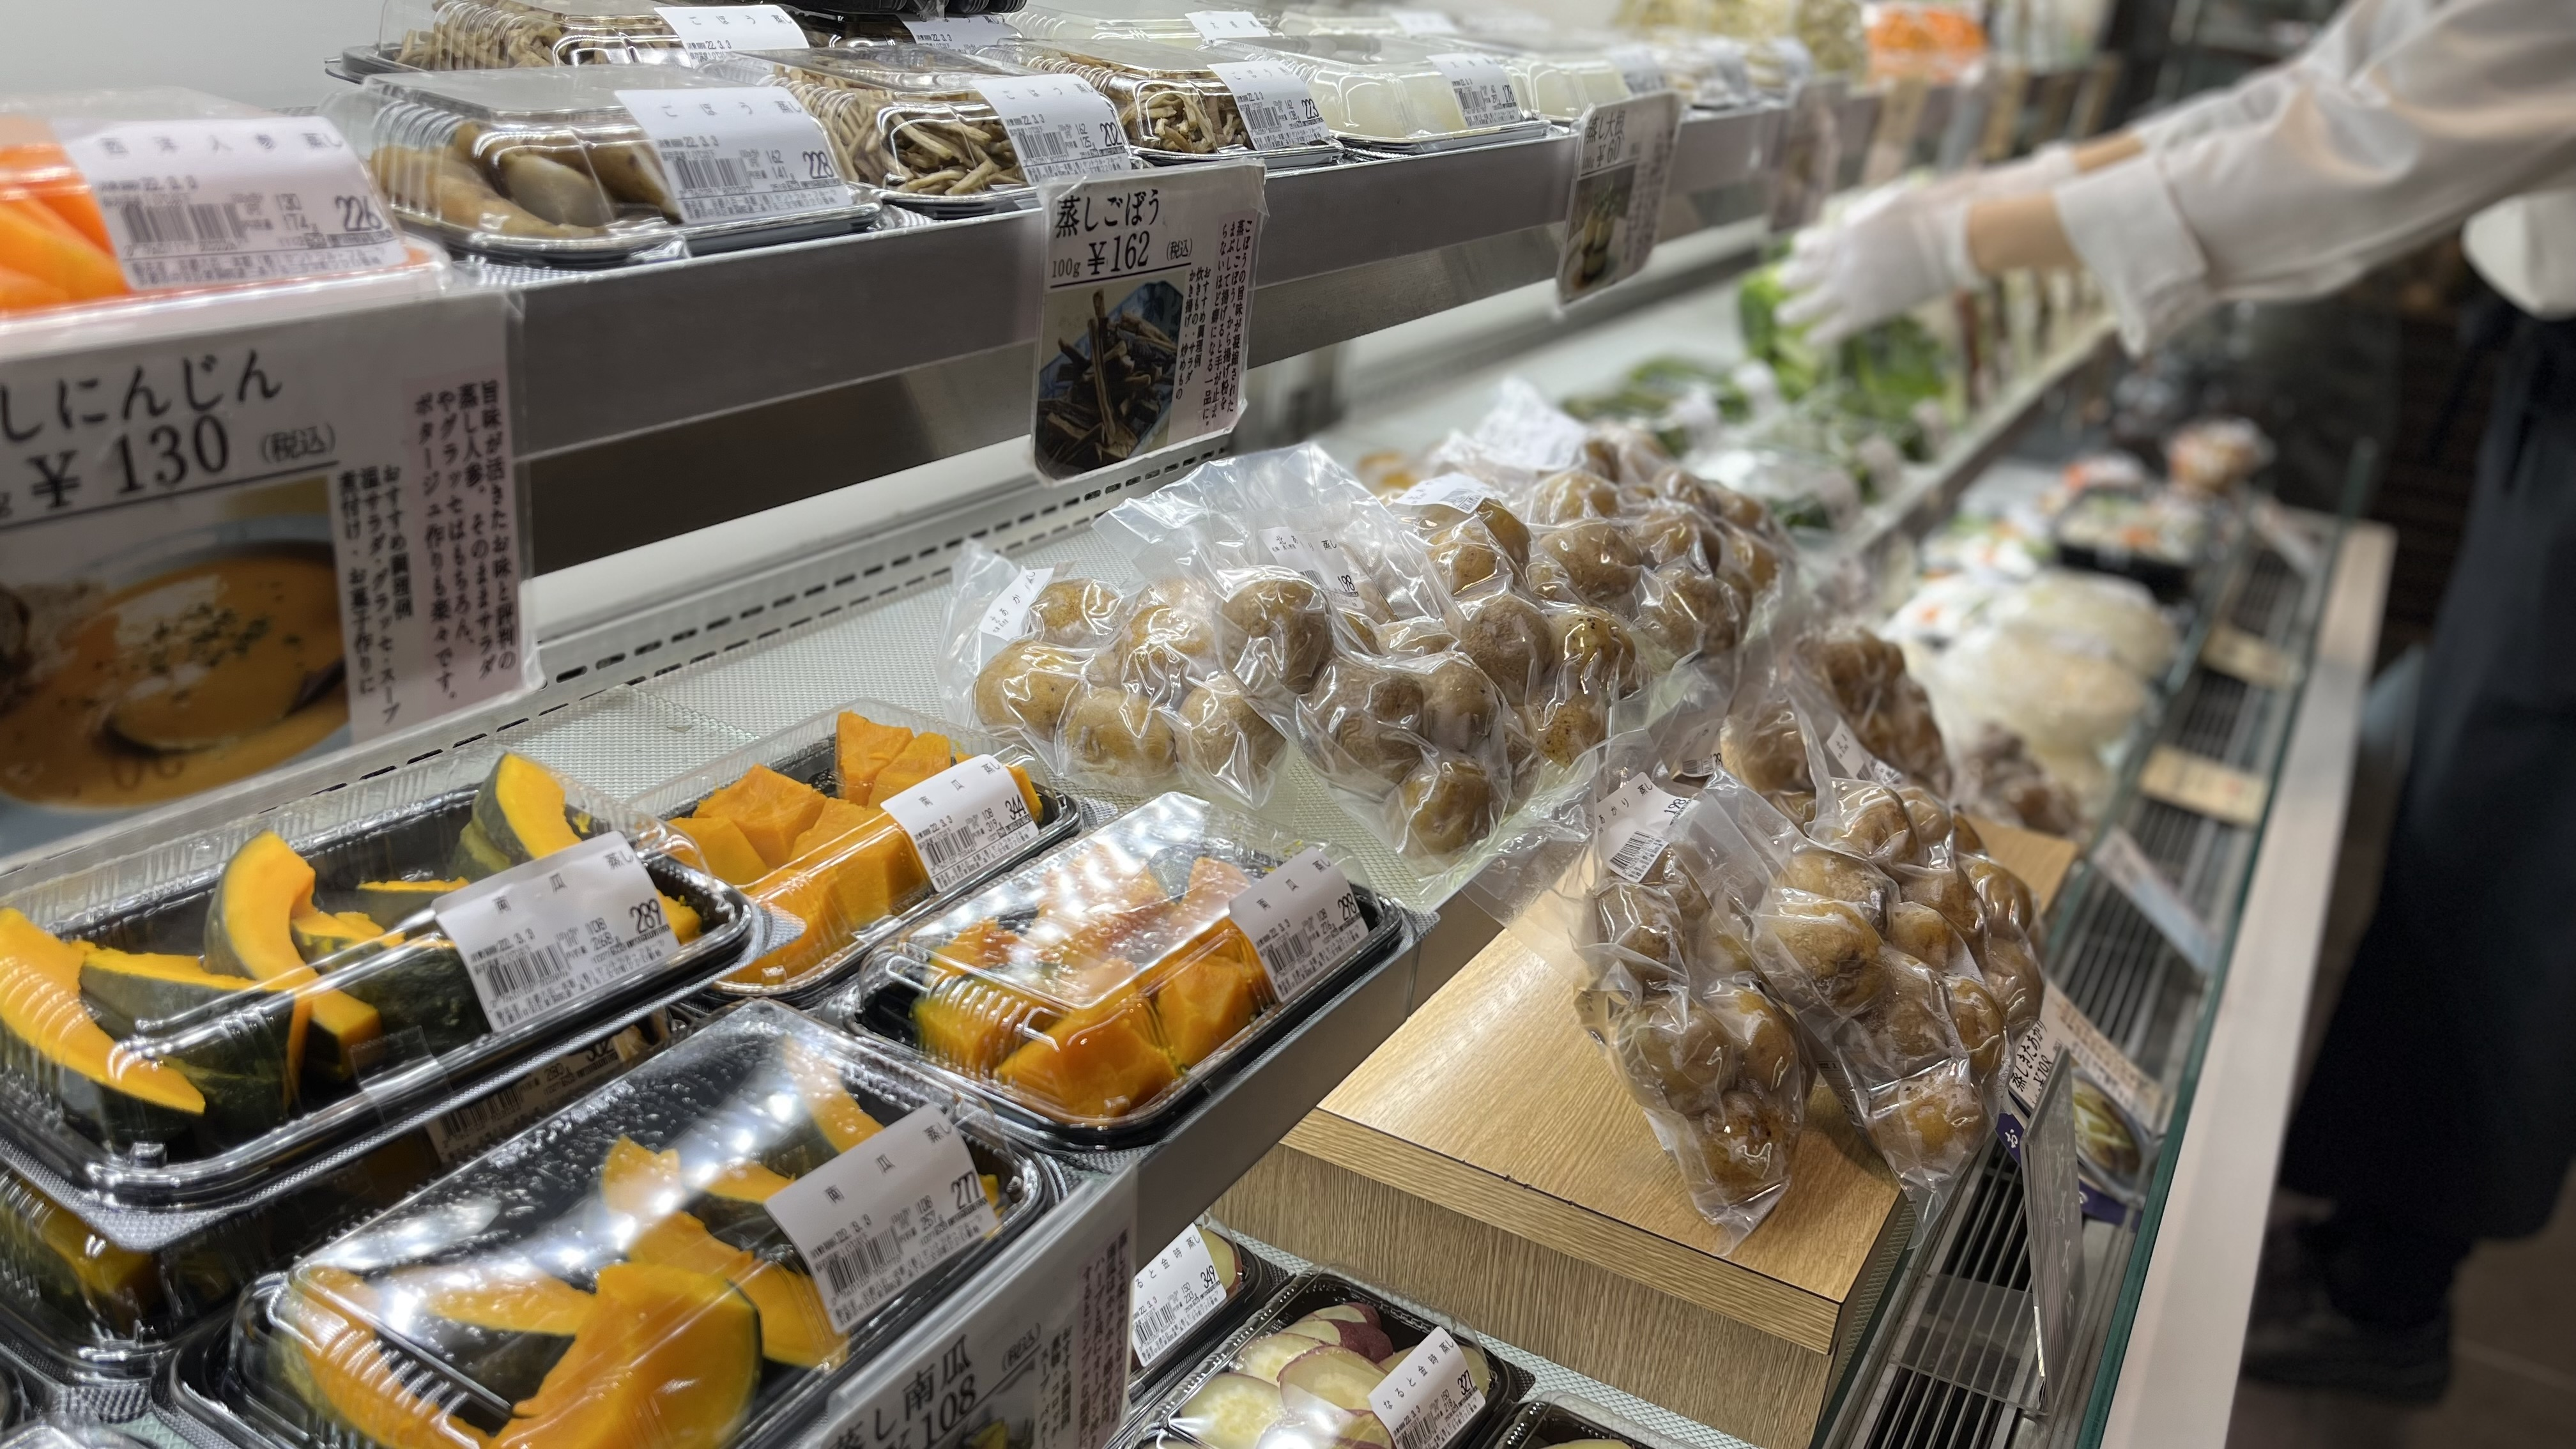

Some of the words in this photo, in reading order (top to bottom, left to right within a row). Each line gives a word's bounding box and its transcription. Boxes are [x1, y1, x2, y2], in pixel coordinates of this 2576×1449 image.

[1502, 84, 1515, 103] 178
[1301, 98, 1319, 119] 223
[1100, 121, 1123, 147] 202
[802, 150, 834, 179] 228
[335, 194, 382, 231] 226
[1055, 189, 1161, 239] 蒸しごぼう
[1052, 257, 1080, 278] 100g
[1167, 239, 1193, 261] (税込)
[1338, 574, 1356, 592] 198
[1004, 794, 1027, 820] 344
[1664, 798, 1687, 815] 198
[629, 898, 663, 934] 289
[1337, 893, 1357, 921] 298
[949, 1170, 981, 1211] 277
[1181, 1282, 1192, 1294] 150
[1200, 1264, 1216, 1289] 349
[1441, 1388, 1450, 1401] 150
[1457, 1368, 1474, 1396] 327
